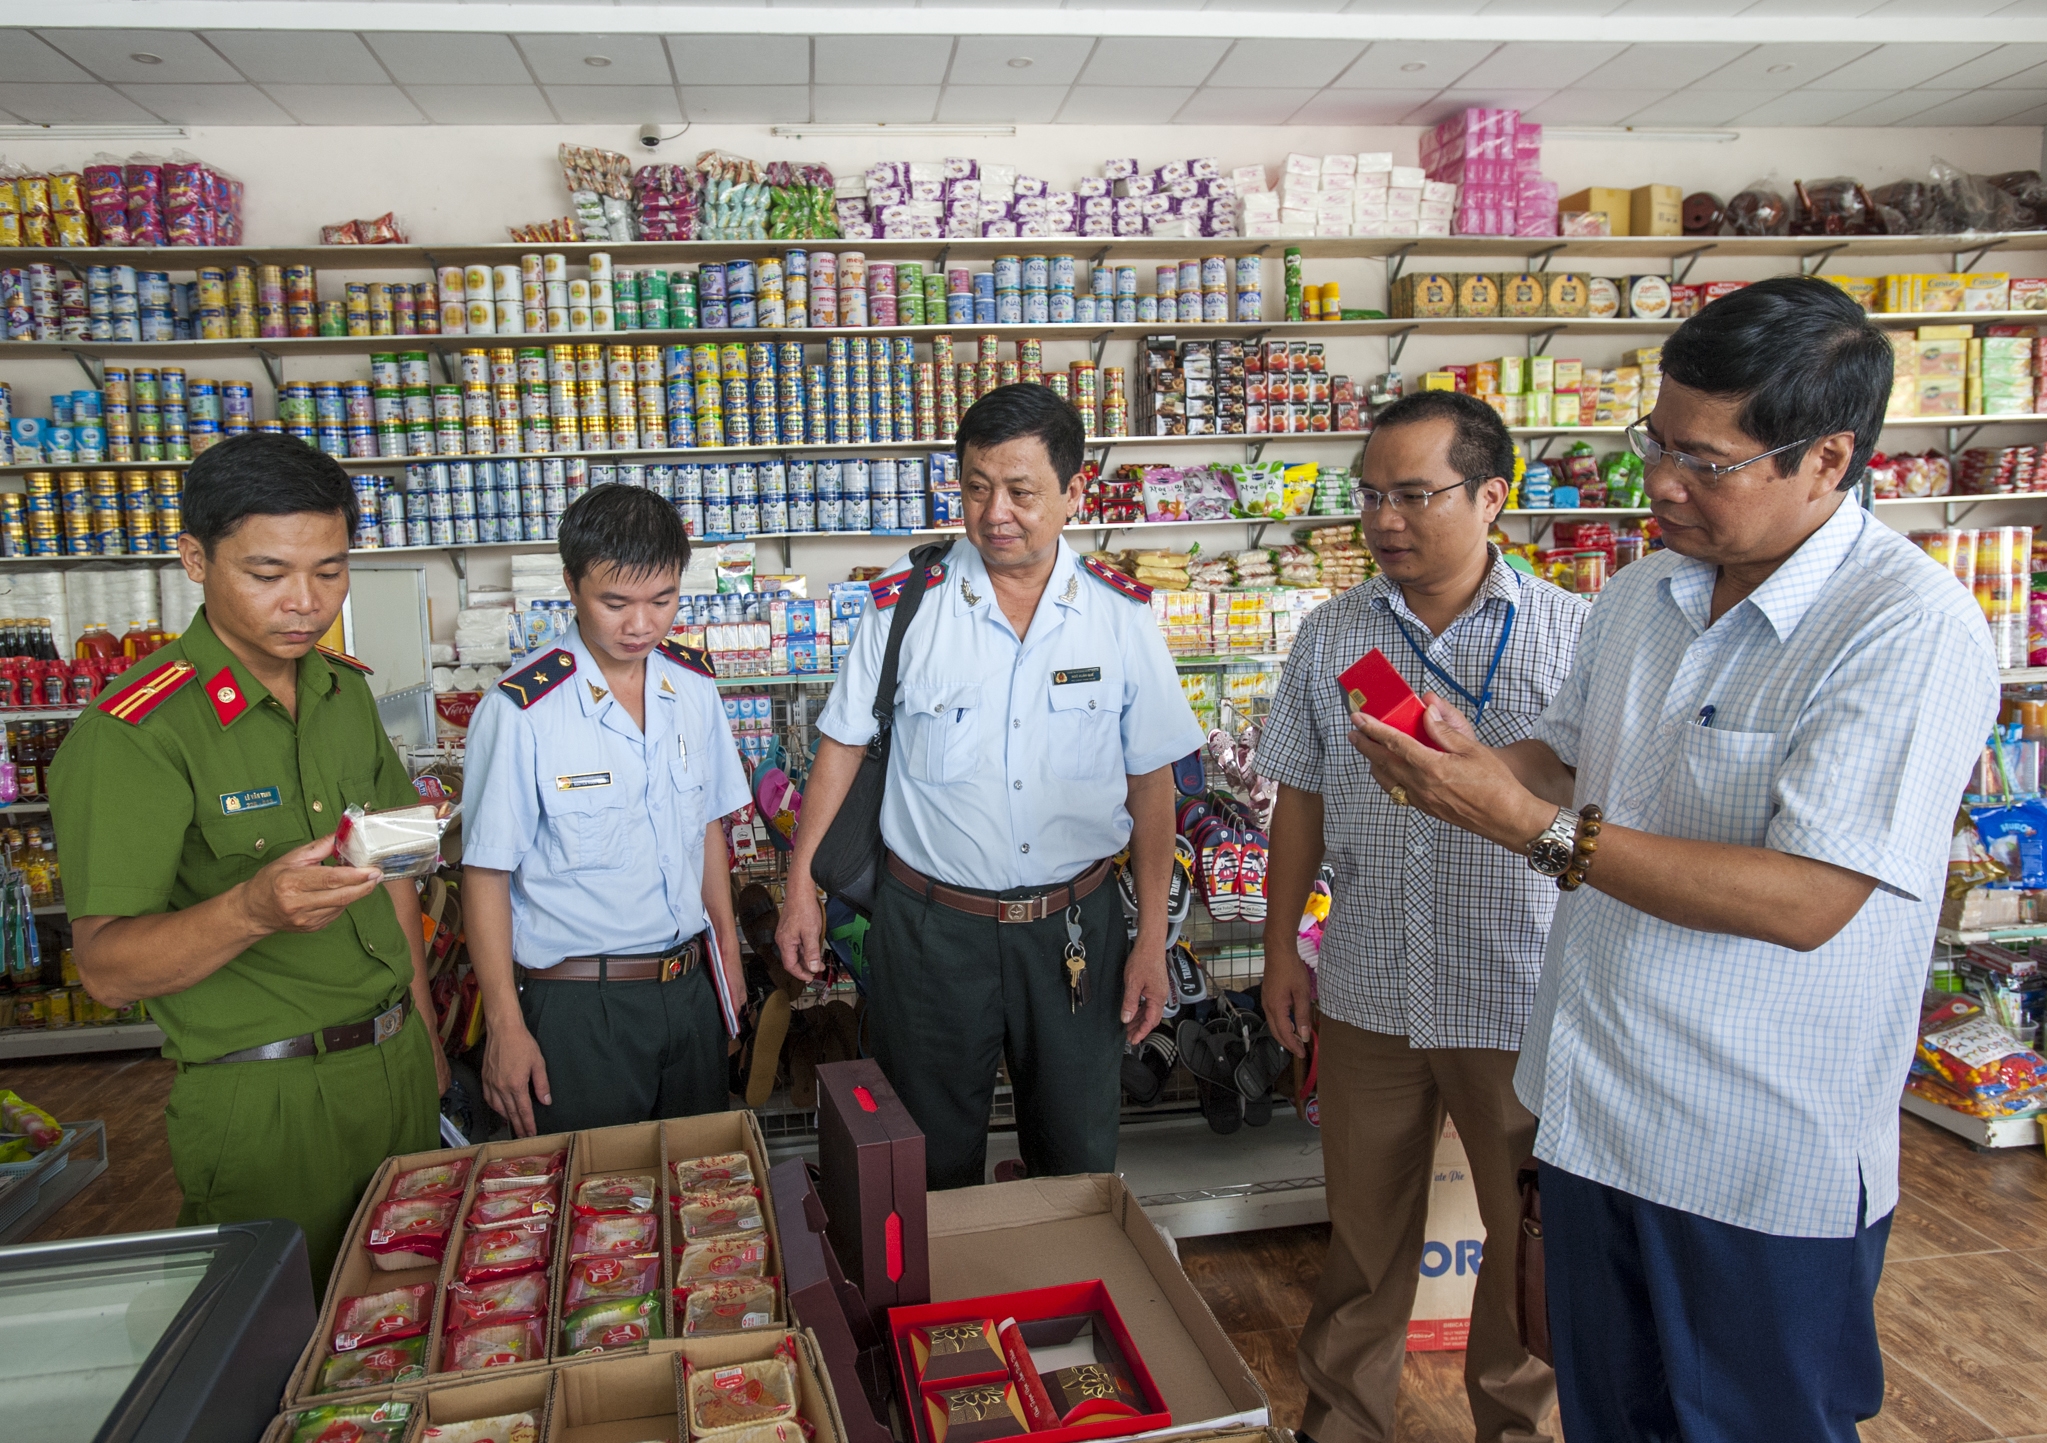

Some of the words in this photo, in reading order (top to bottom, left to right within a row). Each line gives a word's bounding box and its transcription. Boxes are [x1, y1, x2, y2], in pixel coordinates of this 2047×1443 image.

[1030, 264, 1047, 272] NAN
[1051, 299, 1069, 307] NAN
[1449, 1169, 1465, 1183] Pie
